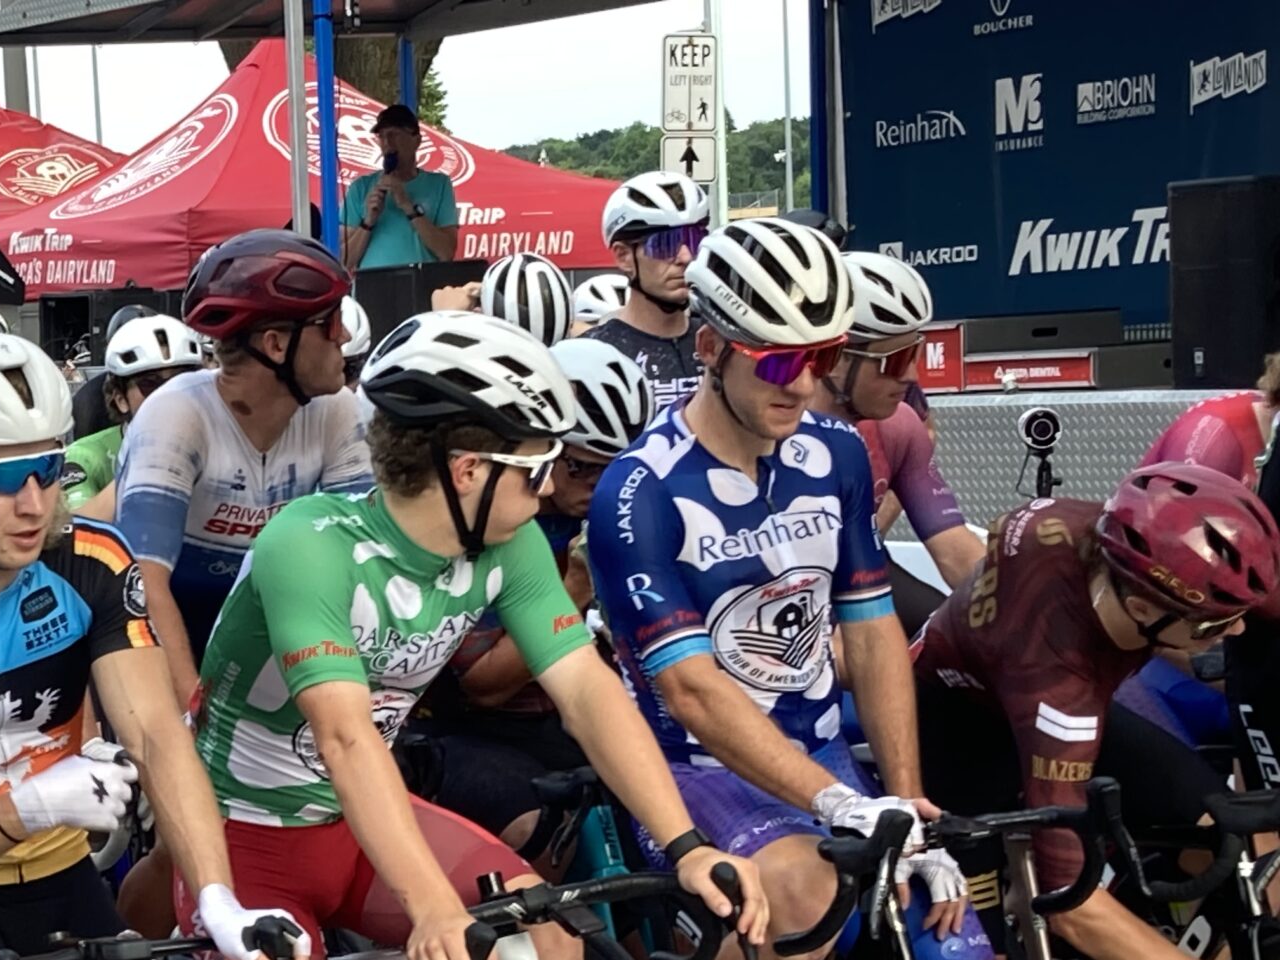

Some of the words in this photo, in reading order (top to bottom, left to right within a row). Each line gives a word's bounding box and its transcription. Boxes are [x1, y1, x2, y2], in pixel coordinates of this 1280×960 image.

[973, 14, 1033, 36] BOUCHER
[669, 43, 711, 67] KEEP
[670, 74, 687, 86] LEFT
[692, 74, 712, 86] RIGHT
[1093, 73, 1156, 110] BRIOHN
[875, 110, 966, 148] Reinhart
[458, 202, 506, 225] TRIP
[464, 229, 575, 259] DAIRYLAND
[904, 244, 979, 268] JAKROO
[46, 259, 117, 285] DAIRYLAND
[503, 374, 548, 410] LAZER
[616, 465, 649, 545] JAKROO
[698, 507, 842, 562] Reinhart
[22, 612, 69, 640] THREE
[25, 622, 70, 651] SIXTY
[748, 667, 764, 681] OF
[1031, 754, 1094, 782] BLAZERS
